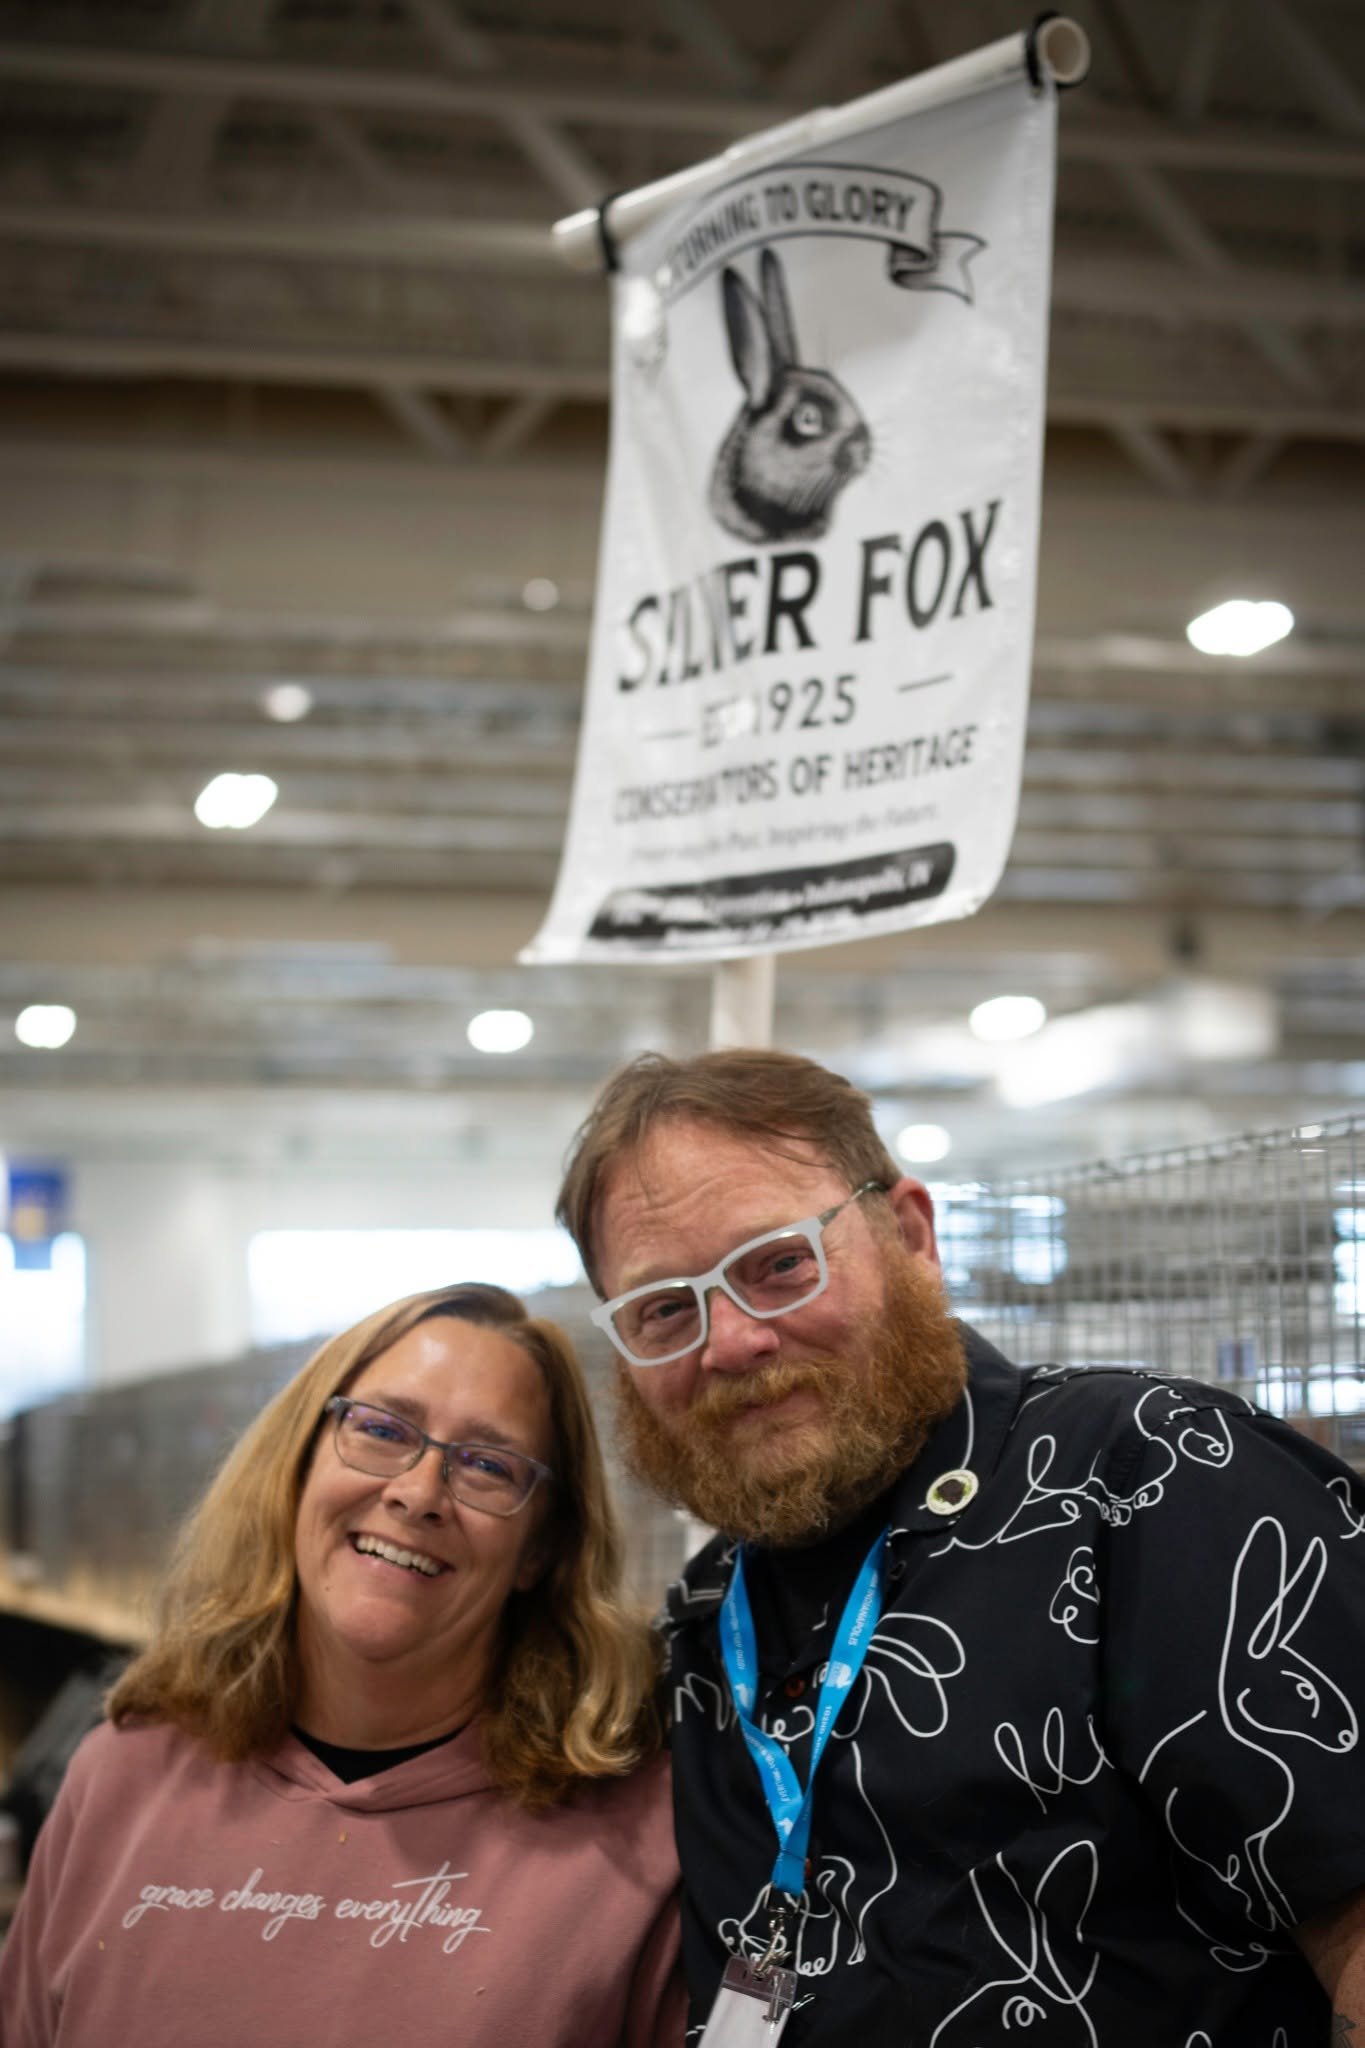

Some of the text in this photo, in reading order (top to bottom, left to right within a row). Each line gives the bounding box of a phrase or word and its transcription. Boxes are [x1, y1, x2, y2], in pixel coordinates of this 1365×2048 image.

[764, 183, 798, 221] TO
[803, 181, 915, 232] GLORY
[853, 500, 1003, 642] FOX
[788, 755, 833, 797] OF
[843, 724, 978, 790] HERITAGE
[121, 1884, 216, 1930] grace
[219, 1867, 327, 1941] changes
